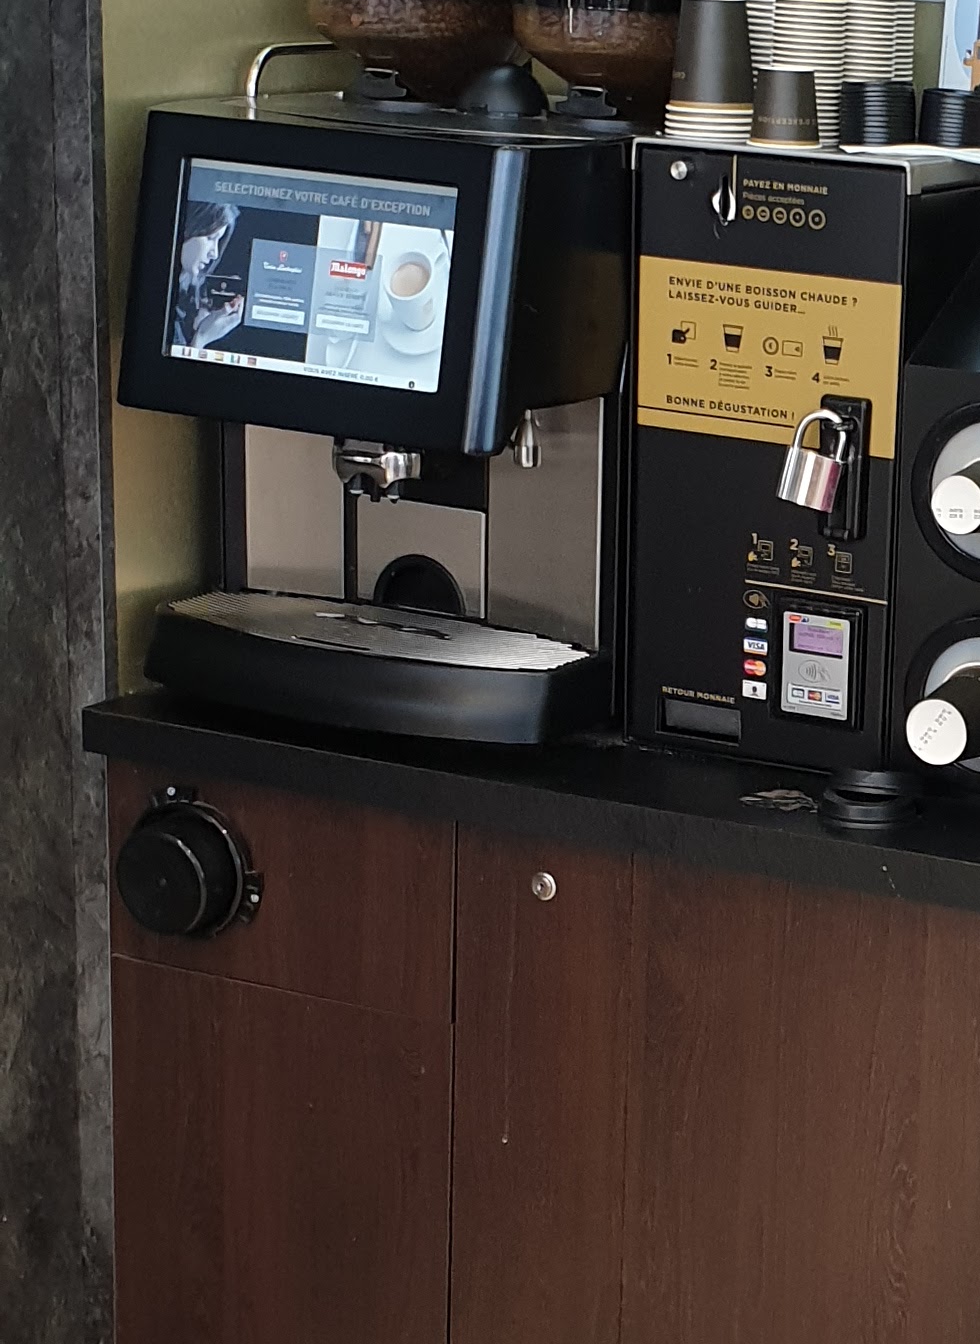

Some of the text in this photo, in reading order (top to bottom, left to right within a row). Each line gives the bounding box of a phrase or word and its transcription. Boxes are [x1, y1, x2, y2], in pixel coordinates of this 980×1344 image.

[743, 178, 829, 195] PAYEZ EN MONNAIE
[295, 190, 328, 205] VOTRE
[330, 193, 358, 208] CAFÉ
[361, 199, 431, 216] D'EXCEPTION
[668, 275, 858, 307] ENVIE D'UNE BOISSON CHAUDE ?
[668, 289, 751, 308] LAISSEZ-VOUS
[666, 353, 673, 366] 1
[709, 359, 718, 370] 2
[764, 366, 773, 378] 3
[811, 372, 820, 384] 4
[666, 394, 705, 409] BONNE
[709, 399, 788, 420] DÉGUSTATION
[751, 532, 758, 545] 1
[789, 538, 799, 551] 2
[827, 543, 836, 556] 3
[748, 641, 765, 650] VISA
[661, 685, 735, 704] RETOUR MONNAIE
